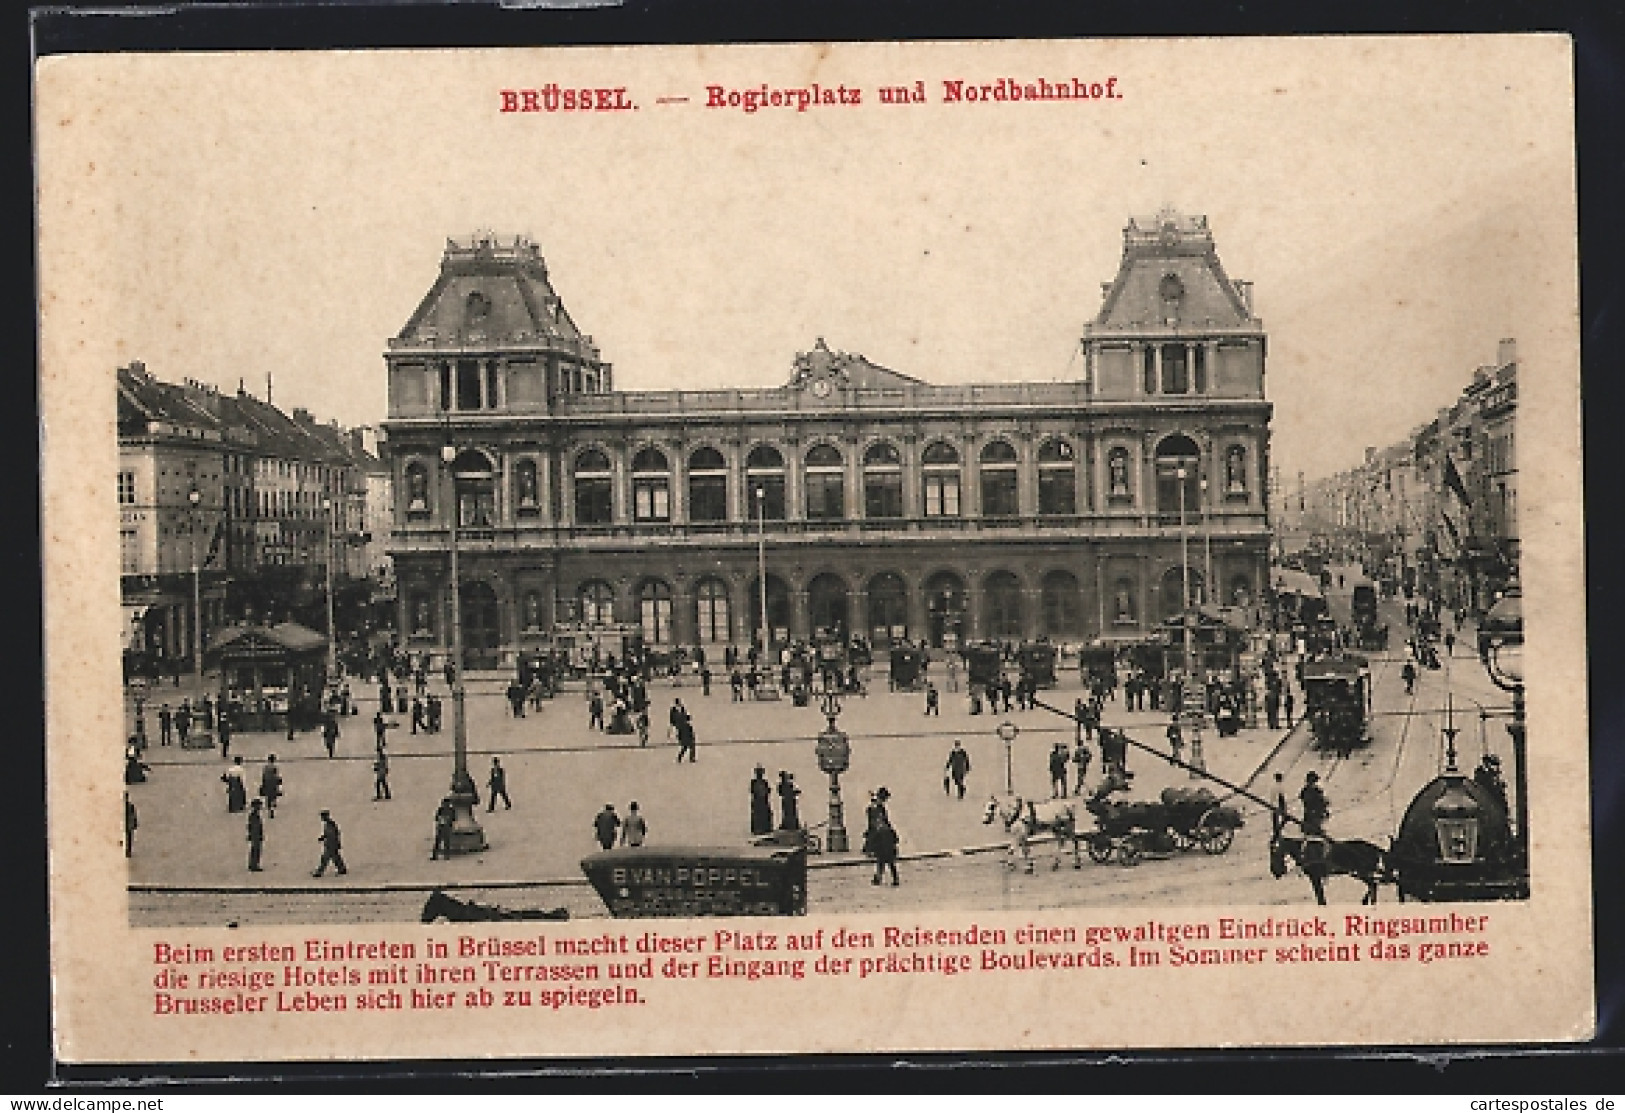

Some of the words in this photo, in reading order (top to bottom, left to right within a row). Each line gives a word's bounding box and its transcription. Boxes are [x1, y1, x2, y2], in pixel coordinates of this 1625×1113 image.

[500, 83, 640, 113] BRÜSSEL.
[705, 84, 862, 112] Rogierplatz
[879, 85, 926, 105] und
[943, 77, 1124, 104] Nordbahnhof.
[154, 942, 215, 964] Beim
[223, 944, 297, 963] ersten
[305, 938, 416, 962] Eintreten
[427, 939, 447, 961] in
[456, 936, 549, 958] Brüssel
[636, 934, 706, 955] dieser
[713, 931, 778, 955] Platz
[786, 932, 824, 953] auf
[832, 929, 874, 951] den
[883, 926, 1007, 950] Reisenden
[1015, 928, 1079, 946] einen
[1084, 921, 1212, 947] gewaltgen
[1345, 912, 1489, 939] Ringsumher
[154, 967, 190, 990] die
[198, 969, 275, 992] riesige
[280, 964, 363, 988] Hotels
[367, 962, 409, 985] mit
[418, 961, 476, 984] ihren
[480, 960, 600, 984] Terrassen
[608, 957, 655, 980] und
[661, 955, 701, 979] der
[706, 955, 806, 982] Eingang
[814, 953, 853, 976] der
[859, 953, 973, 980] prächtige
[979, 947, 1122, 973] Boulevards.
[1128, 946, 1162, 969] Im
[1169, 944, 1268, 967] Sommer
[1273, 940, 1361, 964] scheint
[1368, 939, 1412, 961] das
[1417, 942, 1491, 964] ganze
[154, 993, 268, 1017] Brusseler
[276, 992, 347, 1013] Leben
[356, 990, 404, 1013] sich
[410, 988, 456, 1010] hier
[463, 987, 494, 1009] ab
[502, 989, 532, 1008] zu
[540, 985, 646, 1011] spiegeln.
